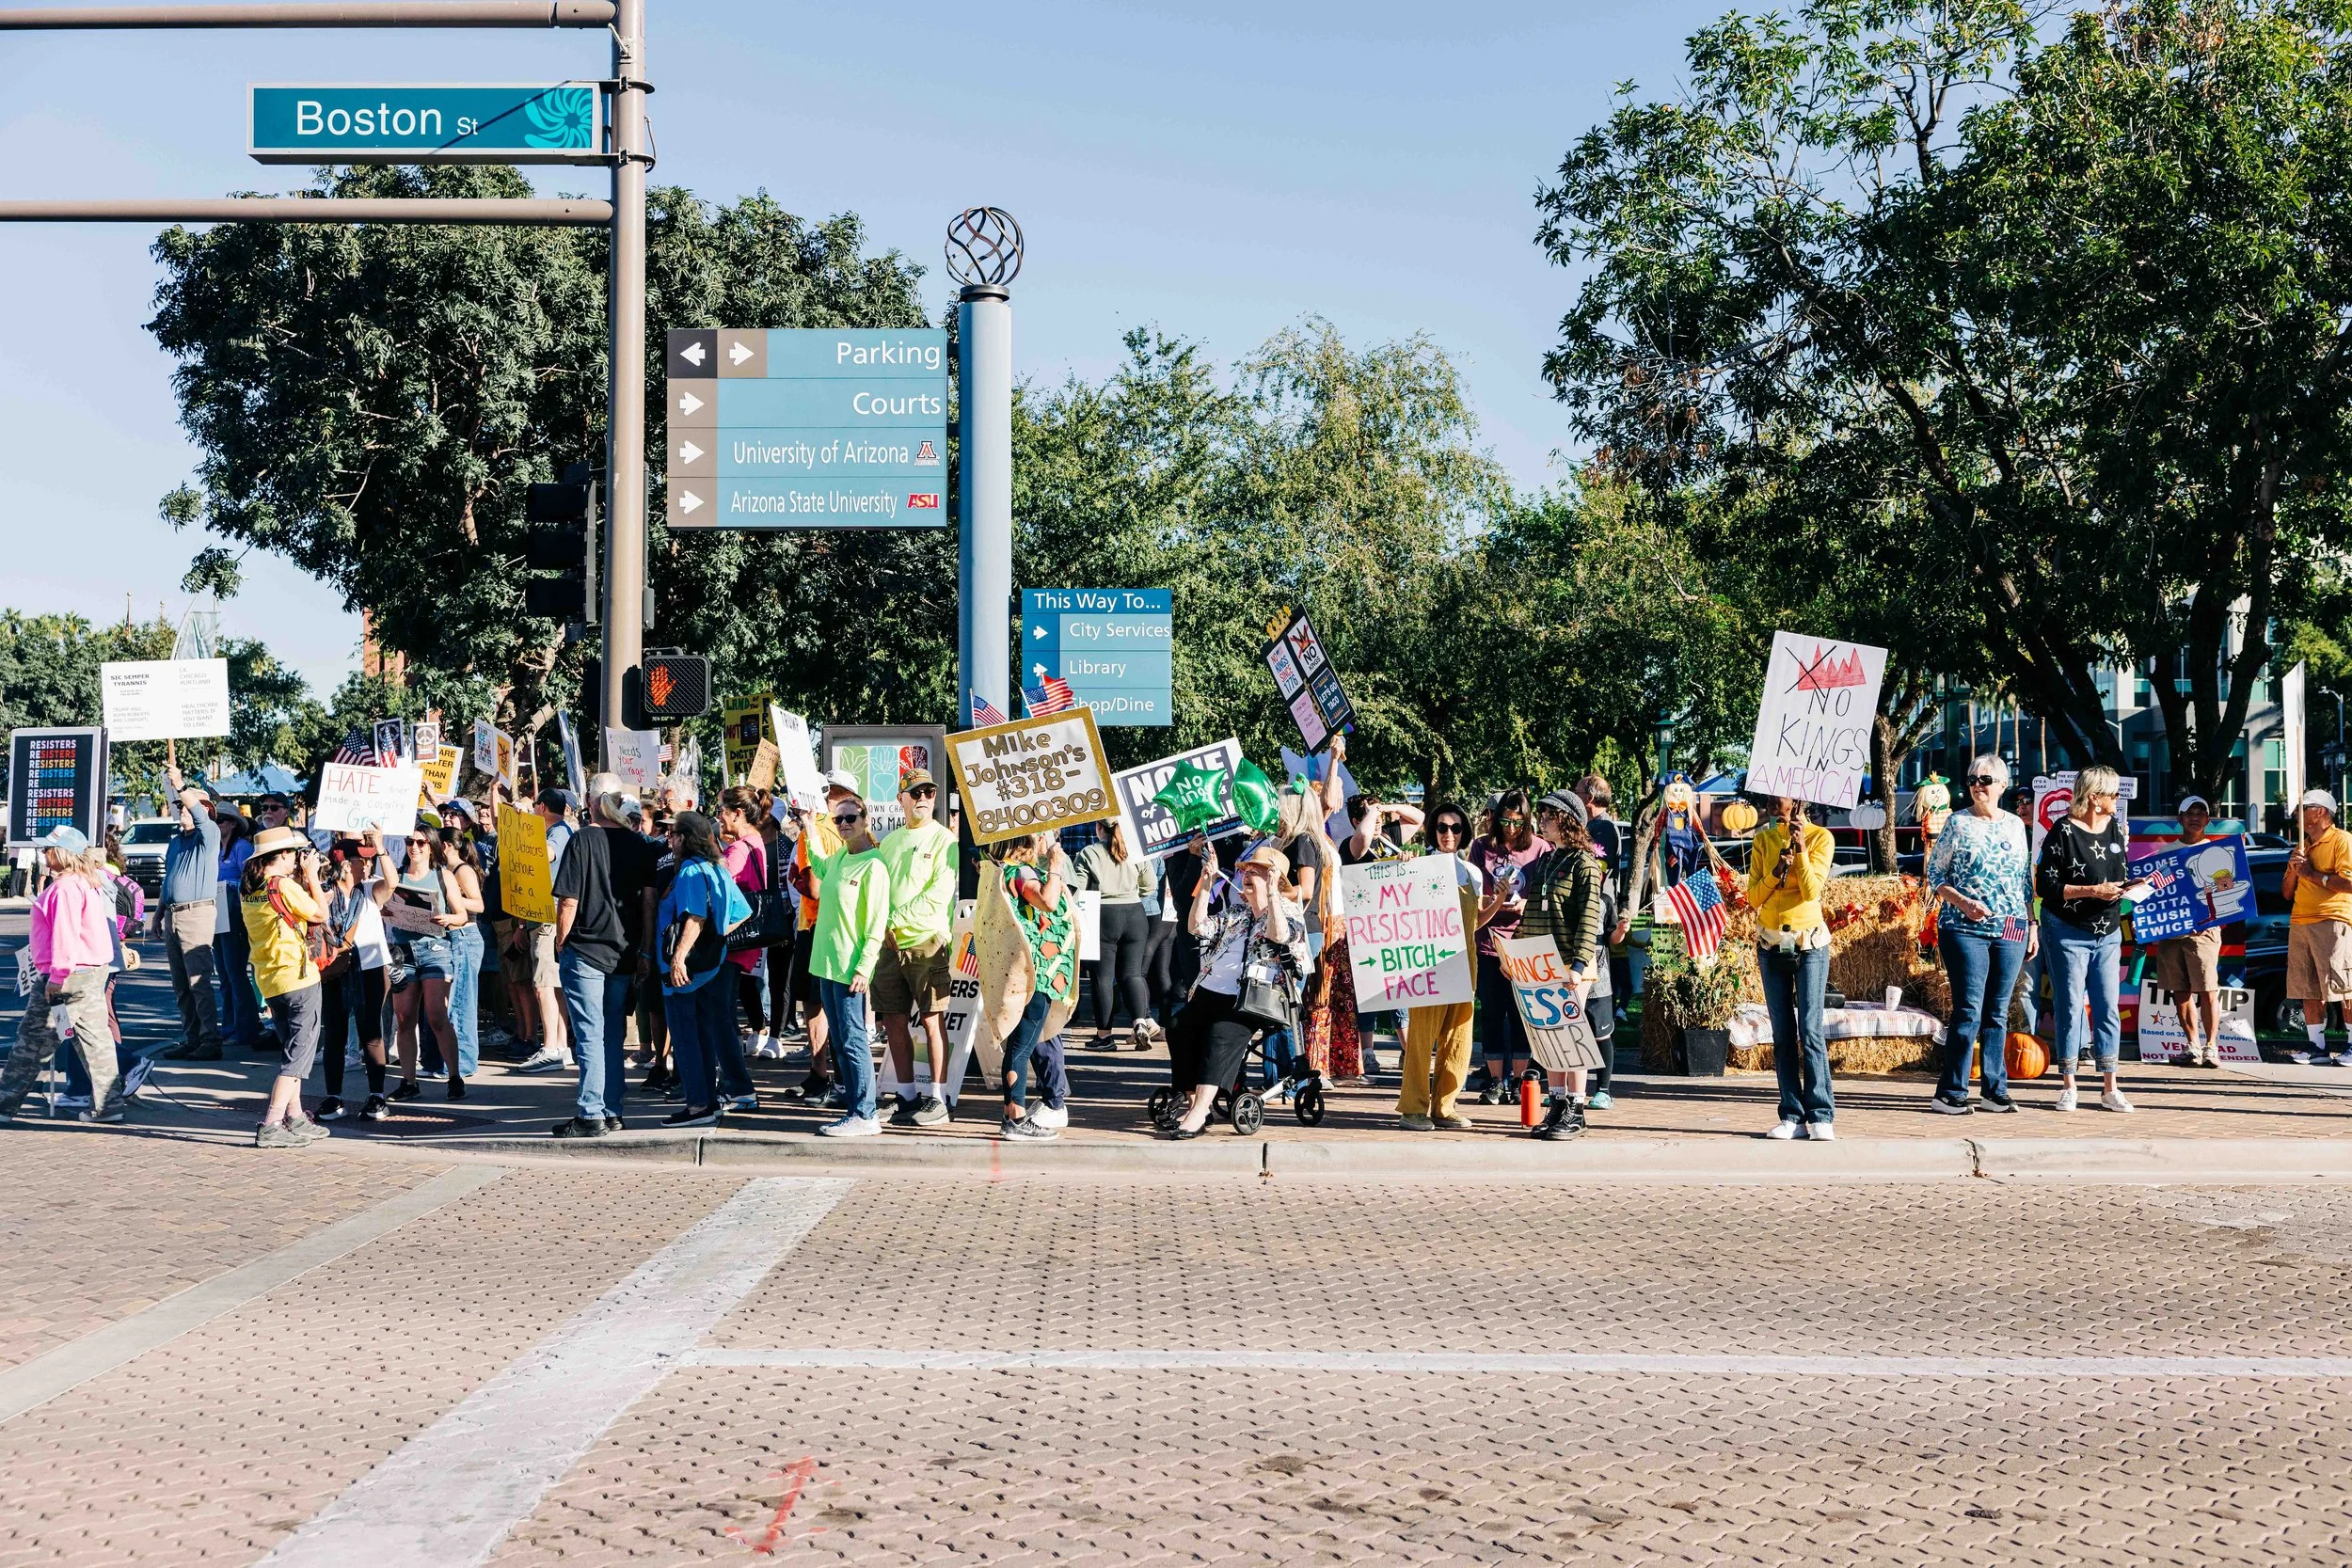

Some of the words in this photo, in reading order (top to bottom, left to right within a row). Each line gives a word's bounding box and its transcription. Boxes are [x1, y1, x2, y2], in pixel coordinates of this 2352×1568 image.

[296, 101, 442, 135] Boston
[456, 118, 479, 135] St
[837, 341, 941, 371] Parking
[852, 392, 942, 415] Courts
[734, 440, 814, 469] University
[820, 440, 840, 464] of
[843, 441, 909, 464] Arizona
[731, 490, 785, 514] Arizona
[789, 490, 824, 514] State
[829, 490, 898, 518] University
[907, 493, 939, 508] ASU
[1034, 593, 1071, 609] This
[1076, 593, 1118, 612] Way
[1122, 593, 1161, 609] To...
[1070, 622, 1101, 641] City
[1106, 623, 1170, 638] Services
[1303, 645, 1317, 665] NO
[1309, 656, 1321, 671] KINGS
[1069, 659, 1126, 677] Library
[1279, 664, 1294, 683] SINCE
[1284, 674, 1298, 693] 1776
[1330, 682, 1338, 692] GO
[1327, 696, 1340, 710] TACO
[1808, 688, 1851, 717] NO
[30, 739, 76, 750] RESISTERS
[619, 745, 641, 758] Needs
[981, 731, 1052, 759] Mike
[1776, 713, 1868, 771] KINGS
[29, 750, 76, 759] RESISTERS
[29, 759, 75, 768] RESISTERS
[1806, 755, 1829, 772] IN
[28, 769, 75, 778] RESISTERS
[327, 769, 381, 794] HATE
[27, 788, 74, 799] RESISTERS
[1746, 764, 1853, 808] AMERICA
[26, 808, 73, 817] RESISTERS
[27, 799, 73, 808] RESISTERS
[977, 788, 1106, 833] 8400309
[1141, 804, 1158, 818] of
[26, 817, 72, 827] RESISTERS
[500, 807, 512, 828] NO
[500, 828, 513, 848] NO
[1365, 864, 1391, 879] THIS
[1396, 863, 1406, 877] IS
[2133, 856, 2178, 875] SOME
[1379, 881, 1413, 909] MY
[2134, 895, 2190, 914] GOTTA
[510, 895, 544, 919] President
[1348, 907, 1461, 945] RESISTING
[2137, 908, 2191, 927] FLUSH
[2138, 919, 2194, 939] TWICE
[1380, 943, 1437, 972] BITCH
[1383, 971, 1439, 1001] FACE
[2141, 1028, 2164, 1037] Based
